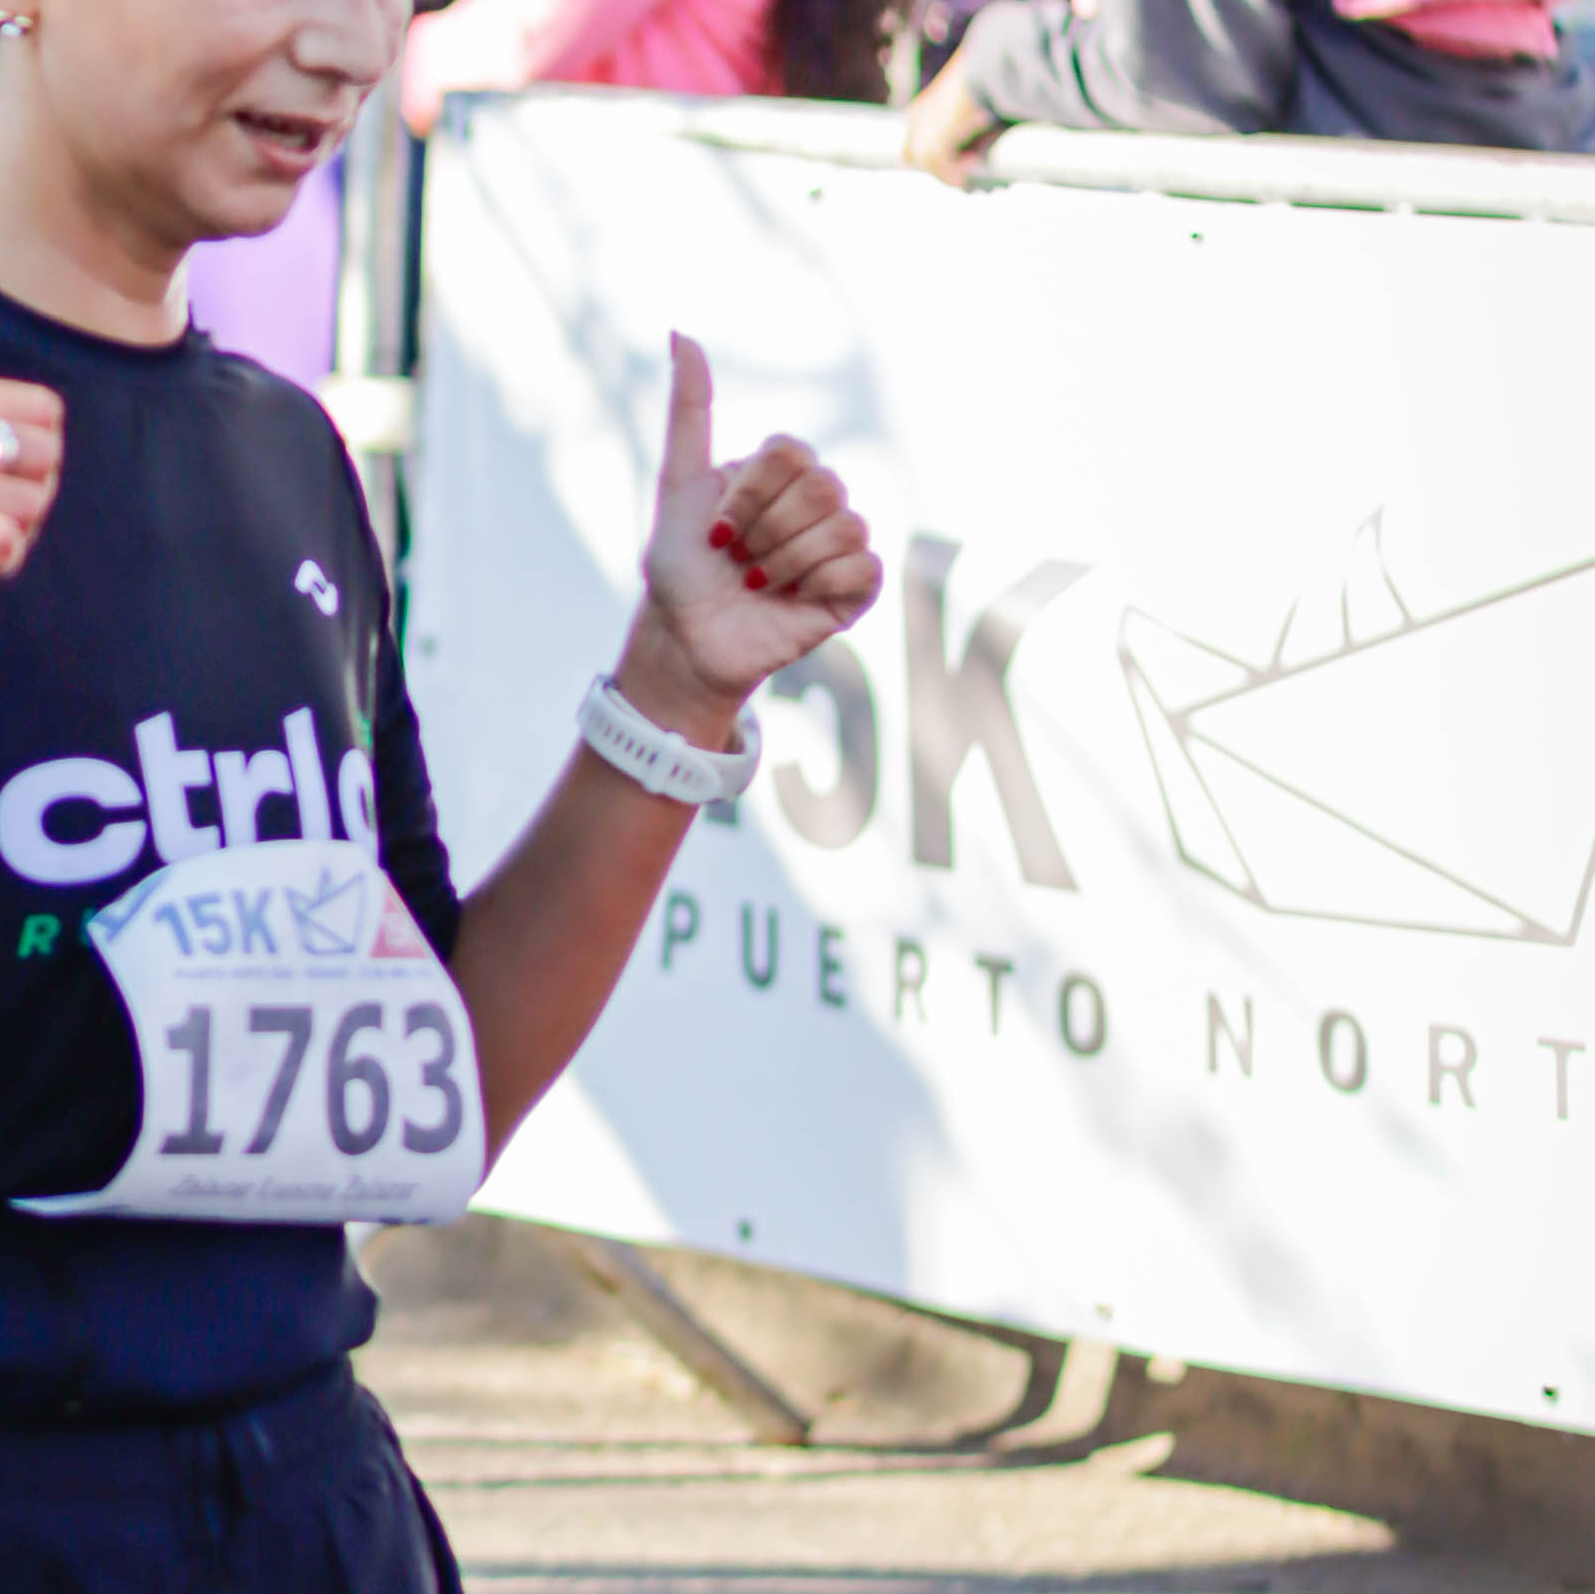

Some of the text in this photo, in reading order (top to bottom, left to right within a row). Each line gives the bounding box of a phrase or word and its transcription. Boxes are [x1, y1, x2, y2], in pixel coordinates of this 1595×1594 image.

[703, 529, 1096, 892] 5K
[152, 887, 278, 957] 15K
[659, 888, 1588, 1123] PUERTO NORT
[158, 1002, 465, 1156] 1763
